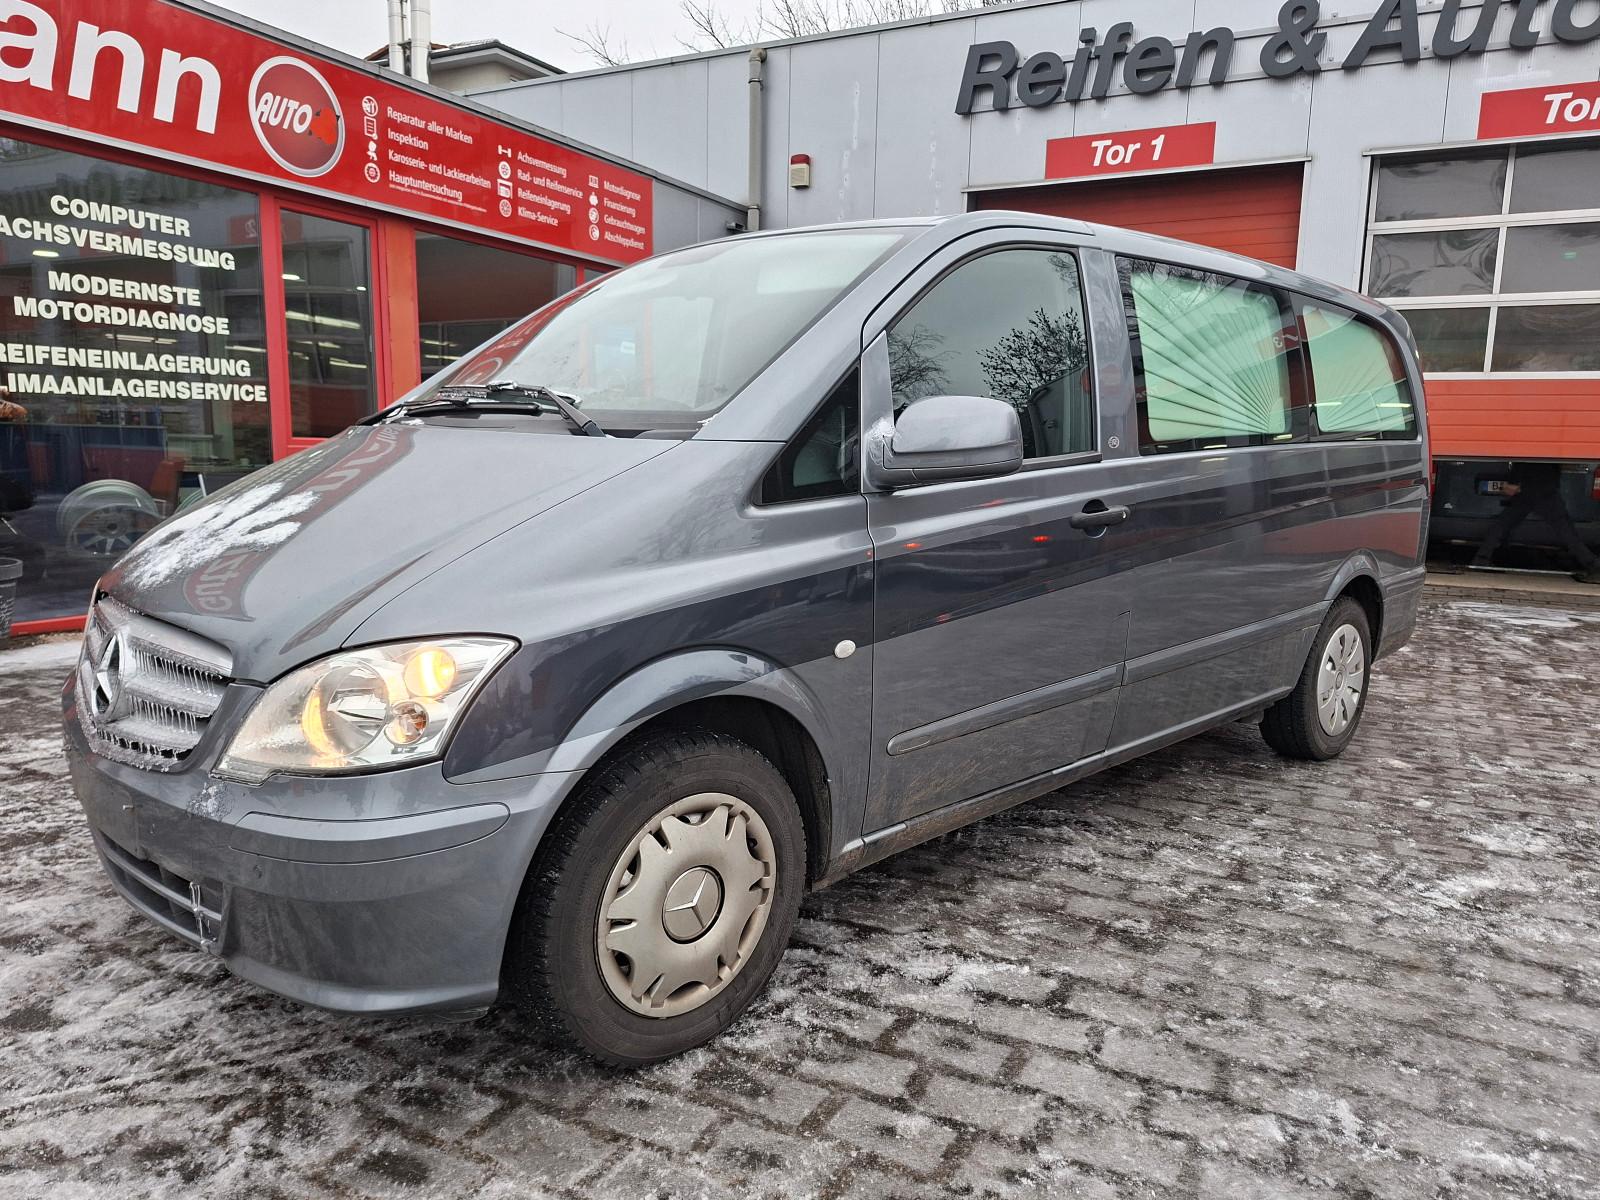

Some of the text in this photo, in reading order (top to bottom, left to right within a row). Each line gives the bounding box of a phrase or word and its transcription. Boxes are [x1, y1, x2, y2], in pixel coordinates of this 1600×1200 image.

[954, 21, 1234, 116] Reifen
[1260, 0, 1327, 79] &
[256, 91, 313, 134] AUTO
[387, 106, 473, 144] Reparatur aller Marken
[387, 128, 429, 151] Inspektion
[1091, 134, 1165, 167] Tor 1
[388, 148, 492, 189] Karosserie- und Lackierarbeiten
[517, 151, 568, 179] Achsvermessung
[388, 169, 463, 202] Hauptuntersuchung
[517, 168, 583, 199] Rad- und Reifenservice
[604, 180, 641, 202] Motordiagnose
[50, 194, 191, 238] COMPUTER
[517, 187, 571, 215] Reifeneinlagerung
[517, 206, 559, 227] Klima-Service
[604, 197, 636, 218] Finanzierung
[603, 213, 646, 235] Gebrauchtwagen
[604, 231, 645, 250] Abschleppdienst
[48, 270, 201, 307] MODERNSTE
[13, 296, 230, 336] MOTORDIAGNOSE
